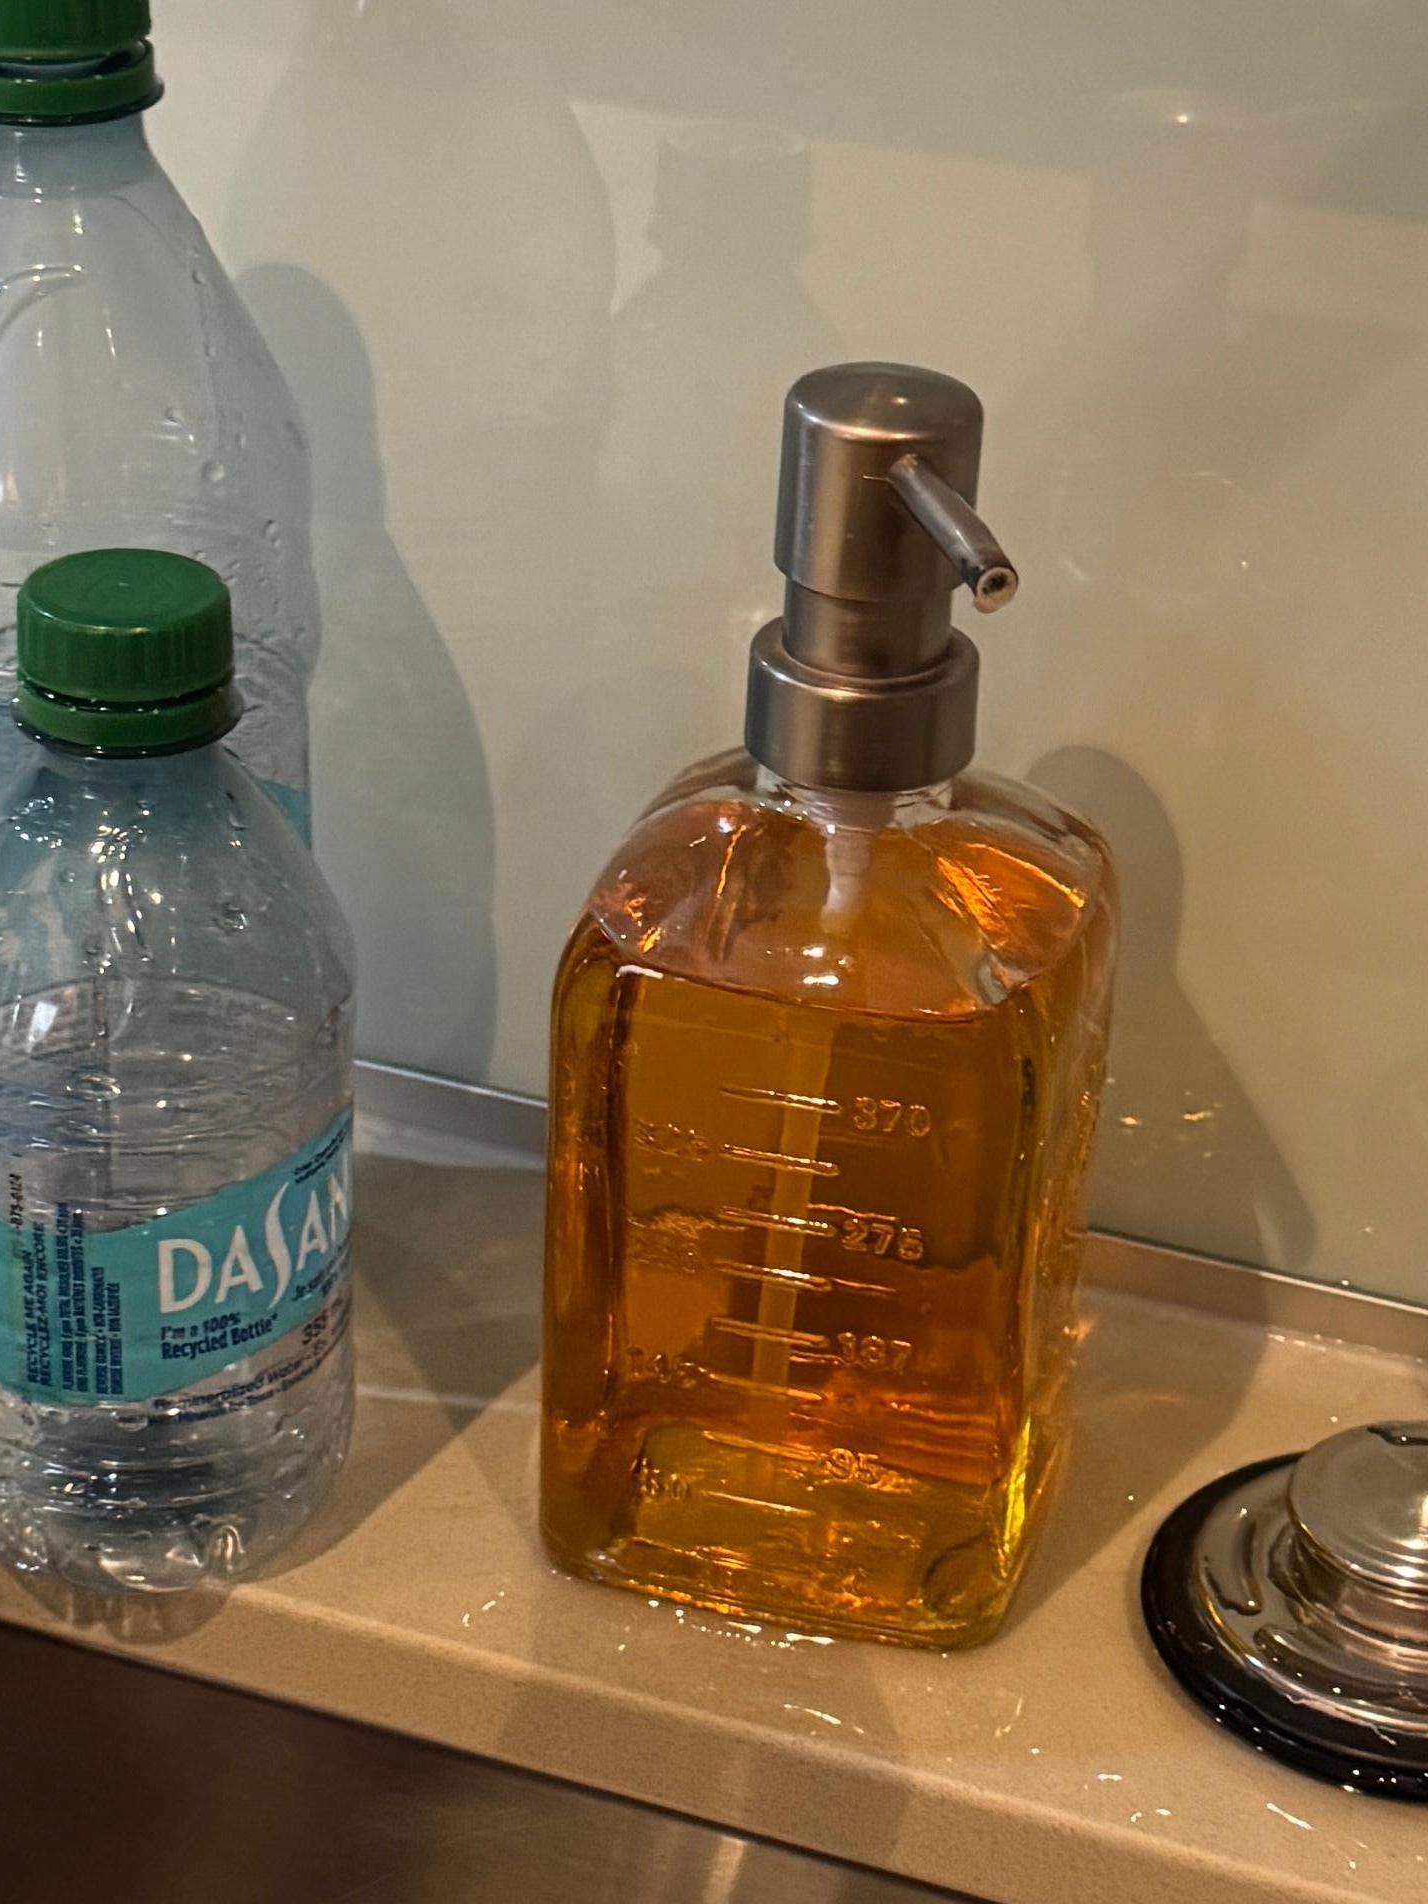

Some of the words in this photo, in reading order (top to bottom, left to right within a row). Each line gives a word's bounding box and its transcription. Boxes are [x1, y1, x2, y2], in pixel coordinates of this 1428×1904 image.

[852, 1095, 933, 1139] 370
[157, 1152, 350, 1314] DASAN
[841, 1217, 925, 1262] 275
[22, 1249, 35, 1294] AGAIN
[24, 1296, 36, 1319] ME
[25, 1323, 39, 1384] RECYCLE
[161, 1334, 228, 1360] Recycled
